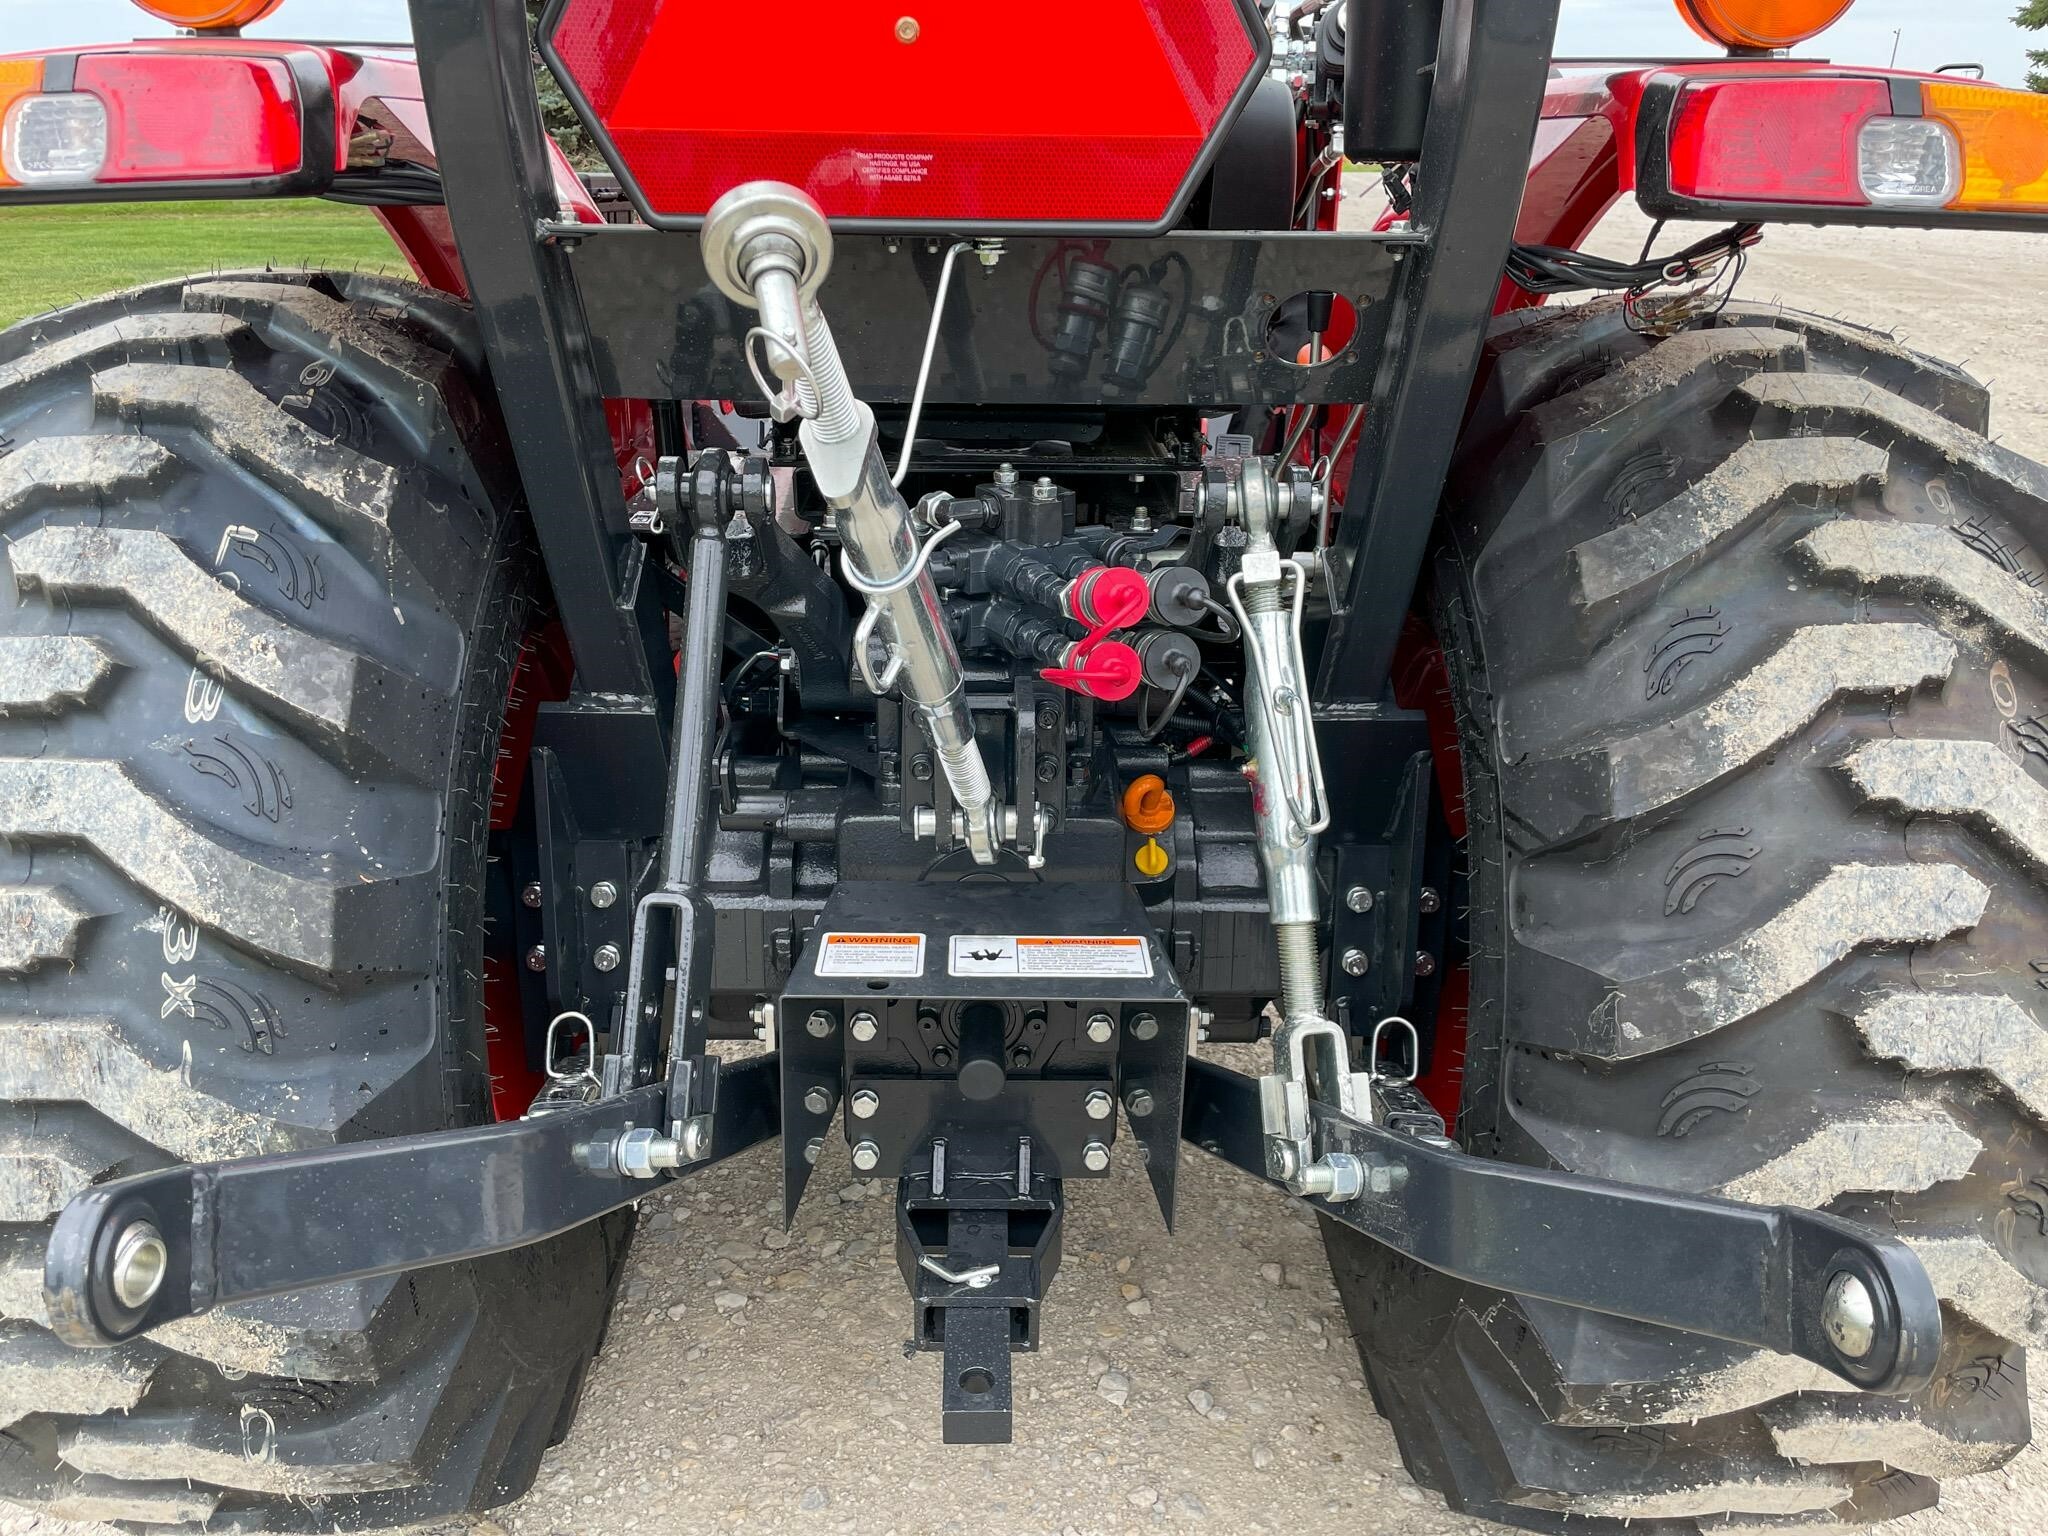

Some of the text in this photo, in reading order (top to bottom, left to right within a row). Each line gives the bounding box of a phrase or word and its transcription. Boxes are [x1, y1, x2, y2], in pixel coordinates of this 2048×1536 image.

[874, 152, 905, 160] PRODUCTS
[906, 153, 933, 161] COMPANY
[892, 167, 928, 175] COMPLIANCE
